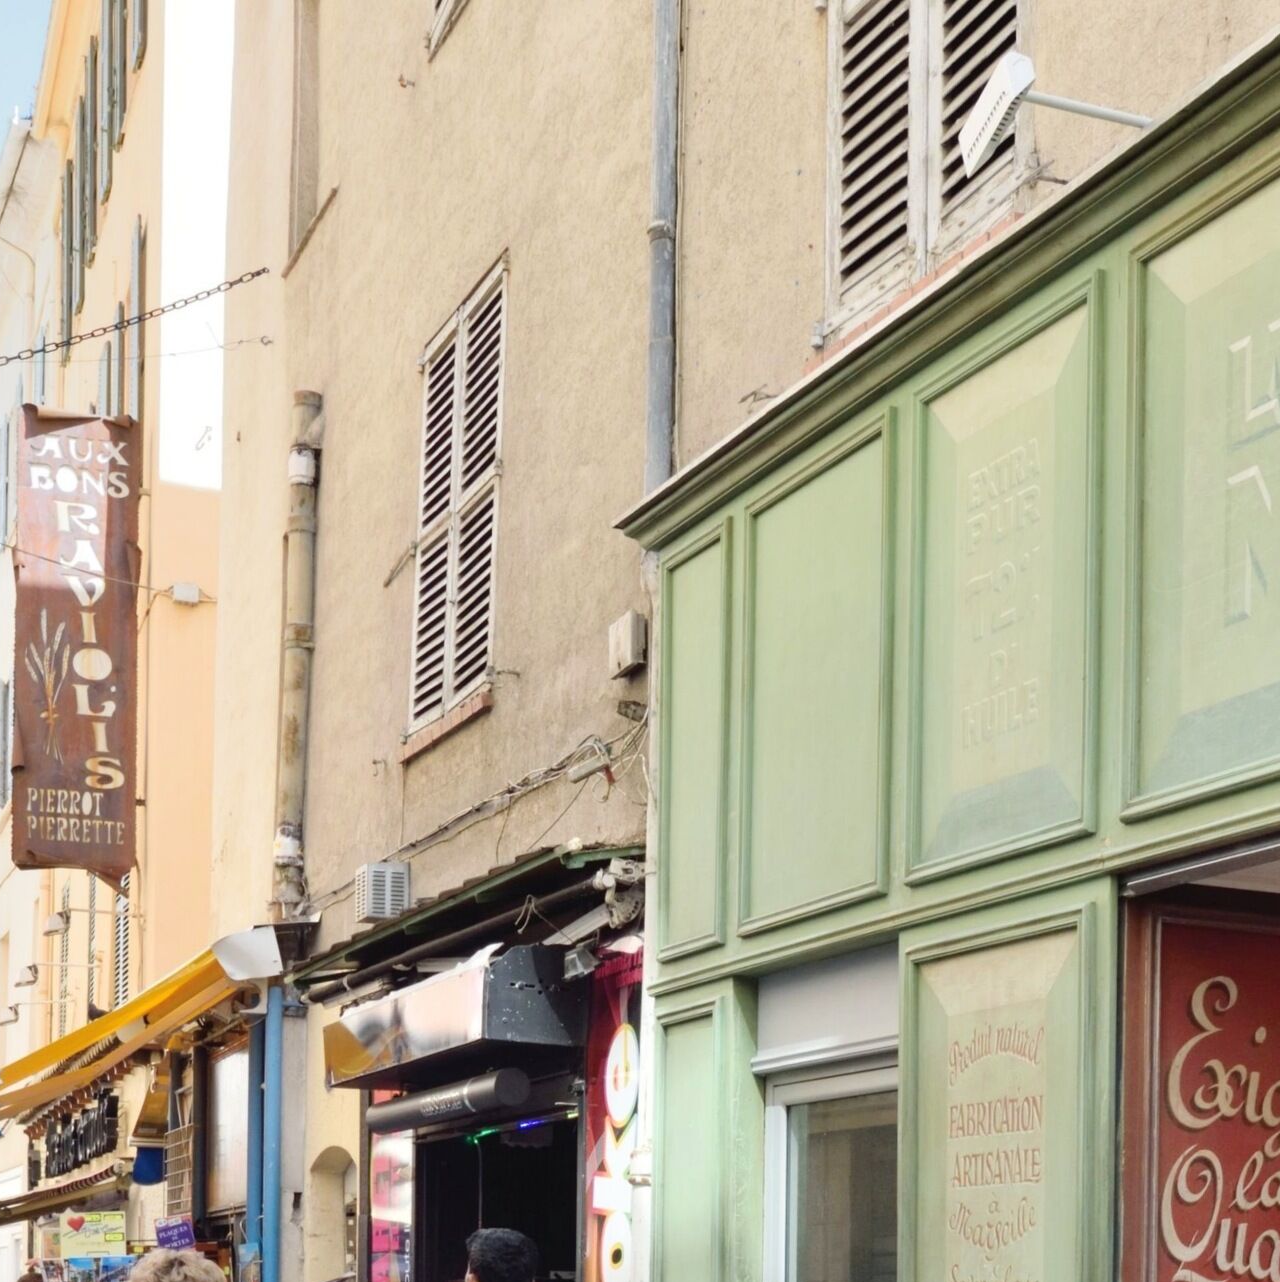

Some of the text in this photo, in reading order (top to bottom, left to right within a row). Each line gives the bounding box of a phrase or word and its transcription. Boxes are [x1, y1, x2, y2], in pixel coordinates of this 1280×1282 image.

[33, 436, 129, 467] AUX
[967, 438, 1041, 511] EXTRA
[30, 462, 130, 499] BONS
[966, 484, 1041, 556] PUR
[56, 501, 127, 791] RAVIOLIS
[27, 787, 104, 817] PIERROT
[27, 815, 125, 846] PIERRETTE
[948, 1022, 1045, 1087] Produit naturel
[948, 1089, 1045, 1139] FABRICATION
[952, 1145, 1042, 1190] ARTISANALE
[948, 1196, 1037, 1262] Marseille
